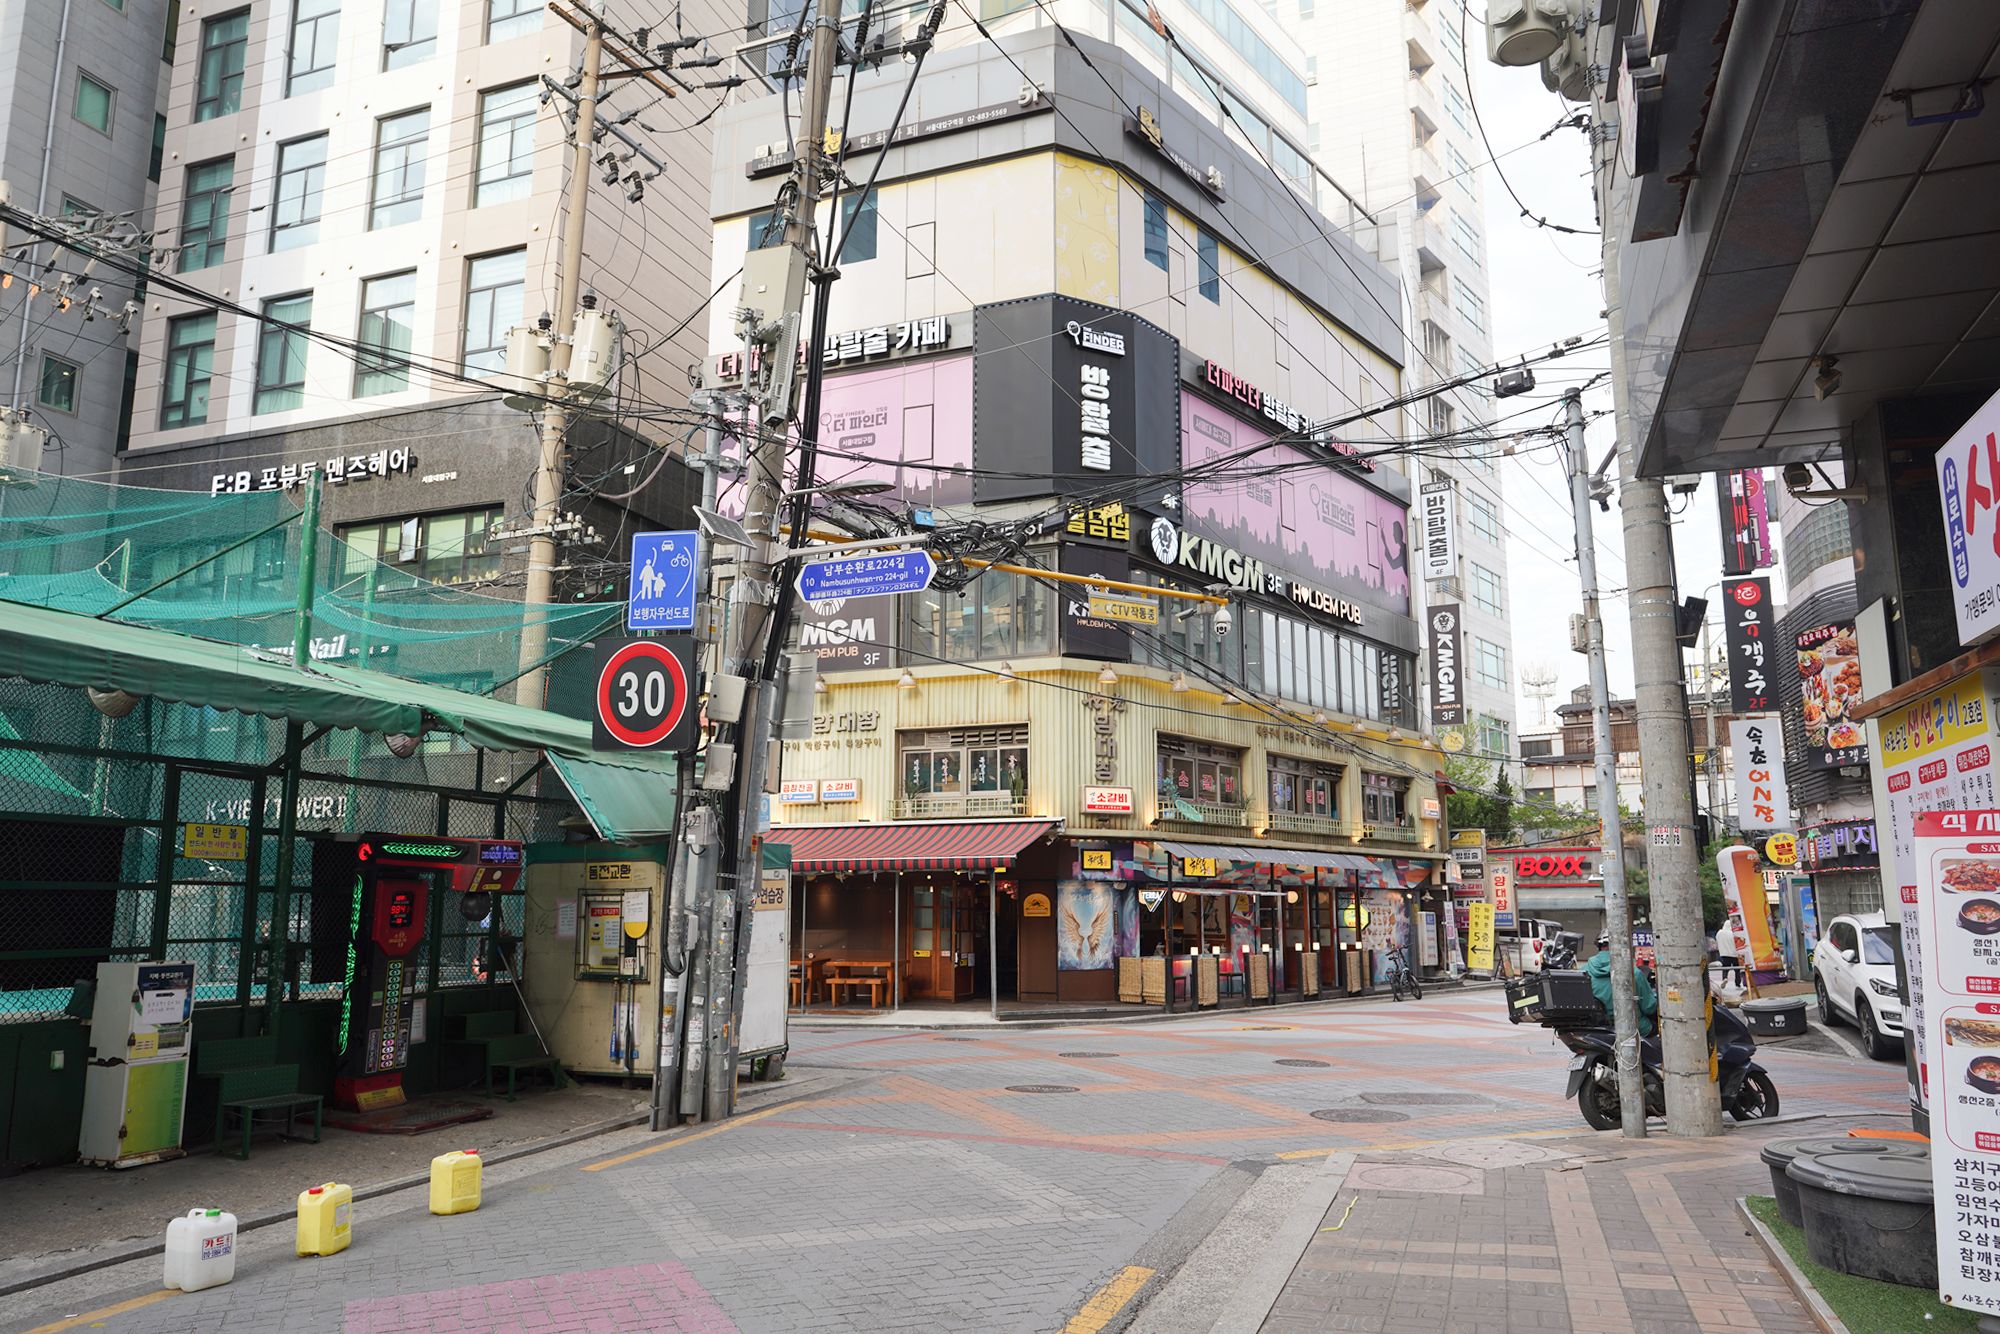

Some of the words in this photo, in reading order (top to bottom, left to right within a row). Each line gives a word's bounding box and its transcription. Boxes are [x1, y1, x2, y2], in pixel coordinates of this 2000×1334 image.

[1017, 81, 1046, 106] 5F
[967, 107, 1008, 122] 02-883-5569
[896, 316, 948, 350] 카페
[1082, 331, 1125, 350] FINDER
[1206, 360, 1260, 411] 더파인더
[1262, 391, 1300, 433] 방탈출
[833, 418, 846, 432] 더
[849, 412, 888, 430] 파인더
[1081, 364, 1112, 471] 방탈출
[326, 446, 409, 484] 맨즈헤어
[1426, 496, 1447, 560] 방탈출
[1945, 464, 1968, 581] 샤로수길
[820, 575, 883, 587] Nambusunhwan-ro
[885, 570, 909, 584] 224-gil
[823, 556, 905, 577] 남부순환로224길
[914, 565, 925, 575] 14
[1179, 531, 1266, 595] KMGM
[1267, 573, 1283, 593] 3F
[1341, 603, 1362, 625] PUB
[805, 578, 815, 587] 10
[632, 606, 691, 621] 보행자우선도로
[1965, 586, 1996, 622] 가맹문의
[801, 618, 876, 646] MGM
[309, 635, 345, 659] Nail
[838, 646, 859, 658] PUB
[864, 652, 881, 667] 3F
[1436, 634, 1456, 704] KMGM
[1382, 651, 1399, 708] MGM
[618, 670, 666, 718] 30
[1749, 697, 1768, 709] 2F
[1442, 711, 1455, 721] 3F
[1907, 692, 1960, 750] 생선구이
[1962, 698, 1983, 726] 2호점
[1094, 714, 1117, 781] 양대창
[1746, 726, 1767, 765] 속초
[826, 782, 853, 792] 소갈비
[1096, 792, 1128, 803] 소갈비
[589, 864, 631, 880] 동전교환
[757, 887, 784, 904] 연습장
[1494, 876, 1508, 911] 양대창
[204, 1236, 224, 1249] 카드
